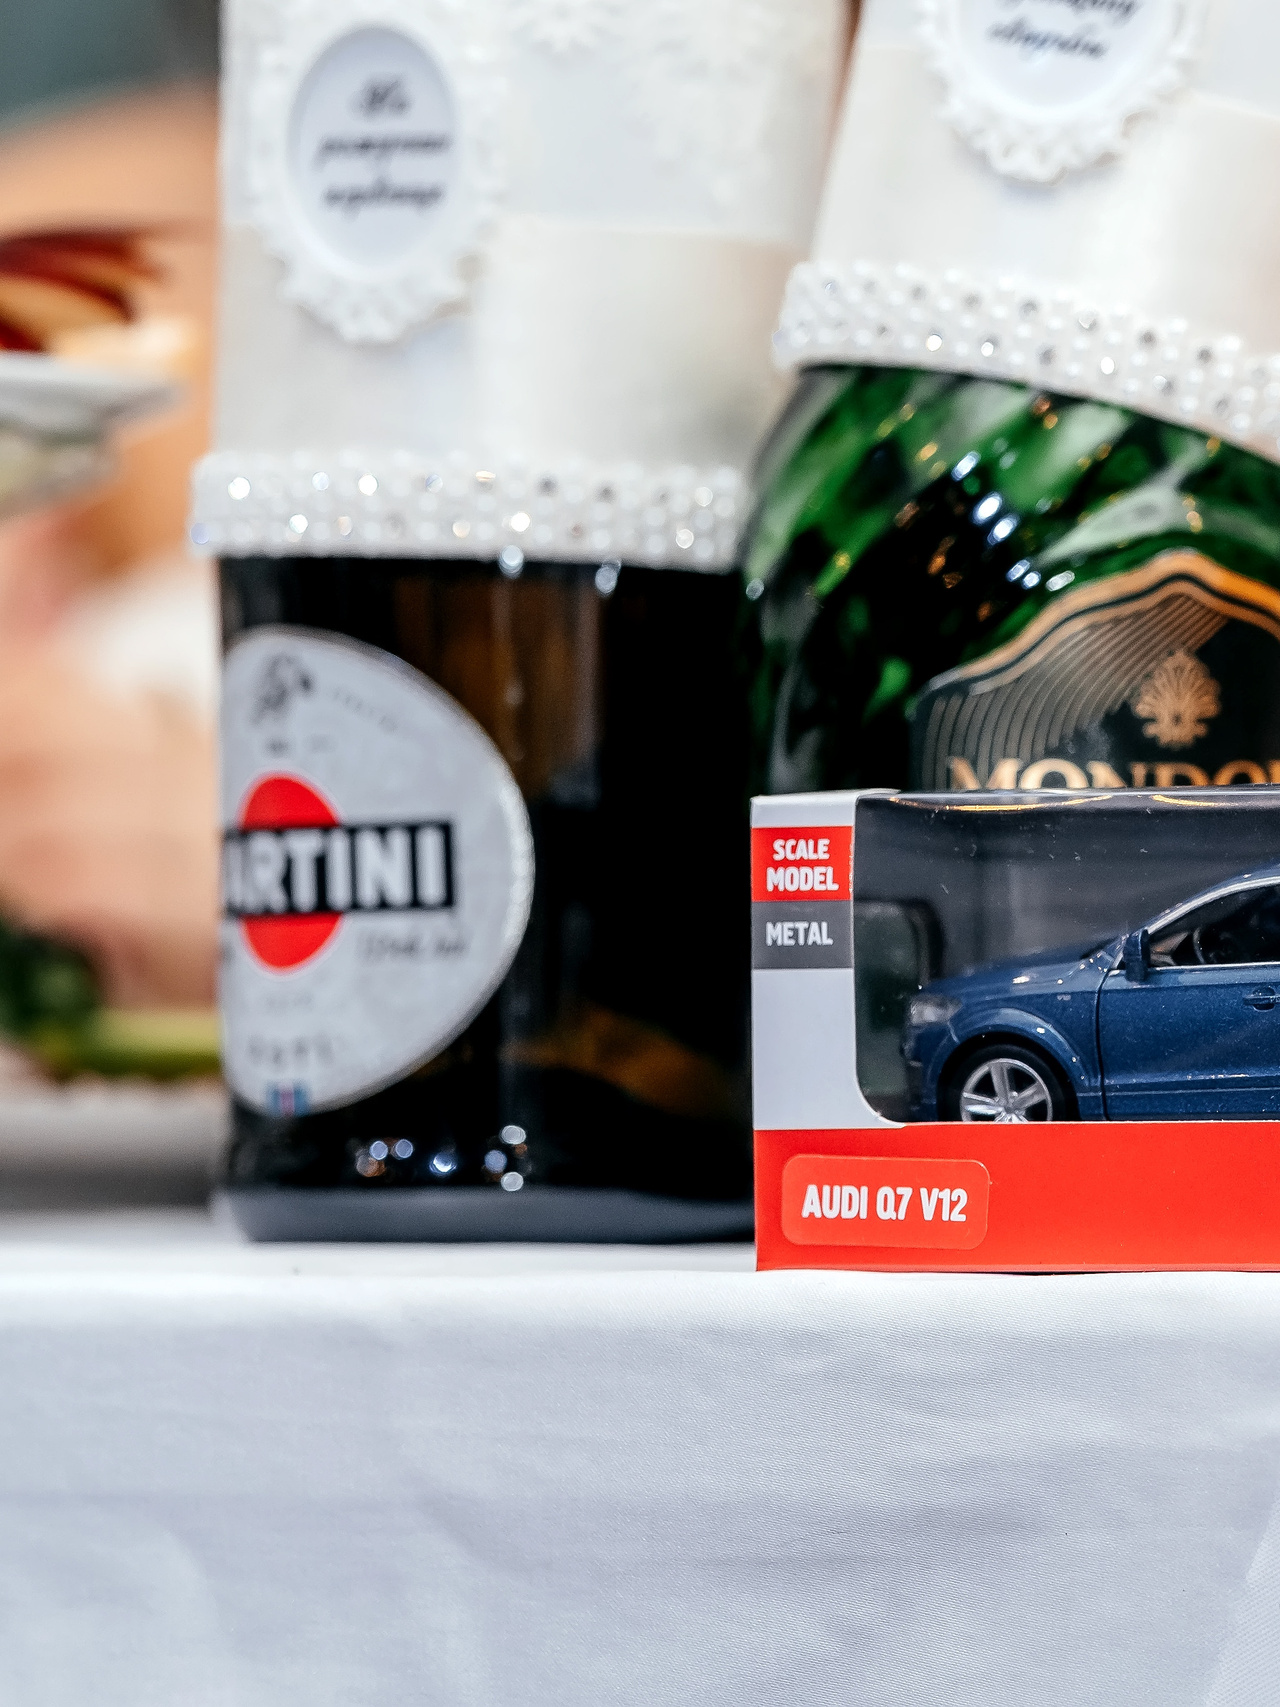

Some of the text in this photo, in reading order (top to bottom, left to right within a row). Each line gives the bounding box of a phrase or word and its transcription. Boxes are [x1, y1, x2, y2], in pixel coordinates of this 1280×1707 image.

[772, 838, 830, 861] SCALE
[766, 866, 839, 892] MODEL
[766, 921, 833, 946] METAL
[801, 1184, 968, 1222] AUDI Q7 V12
